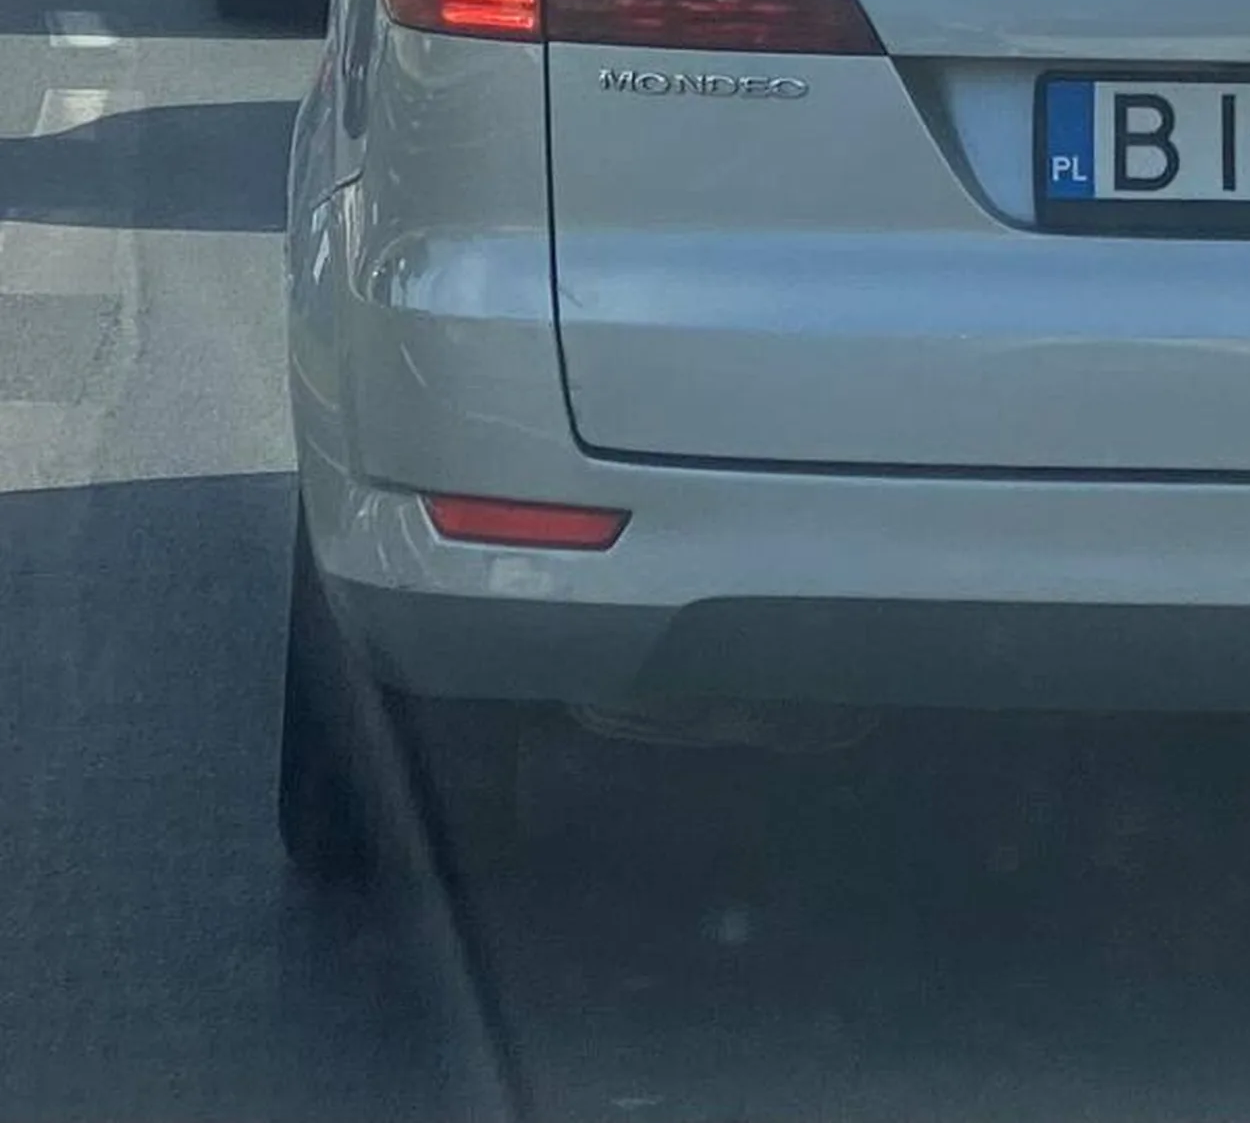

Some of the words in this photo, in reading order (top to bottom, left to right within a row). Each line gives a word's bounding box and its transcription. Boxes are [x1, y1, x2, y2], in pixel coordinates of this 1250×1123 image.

[600, 68, 809, 100] MONDEO
[1113, 93, 1236, 192] BI
[1052, 156, 1087, 181] PL
